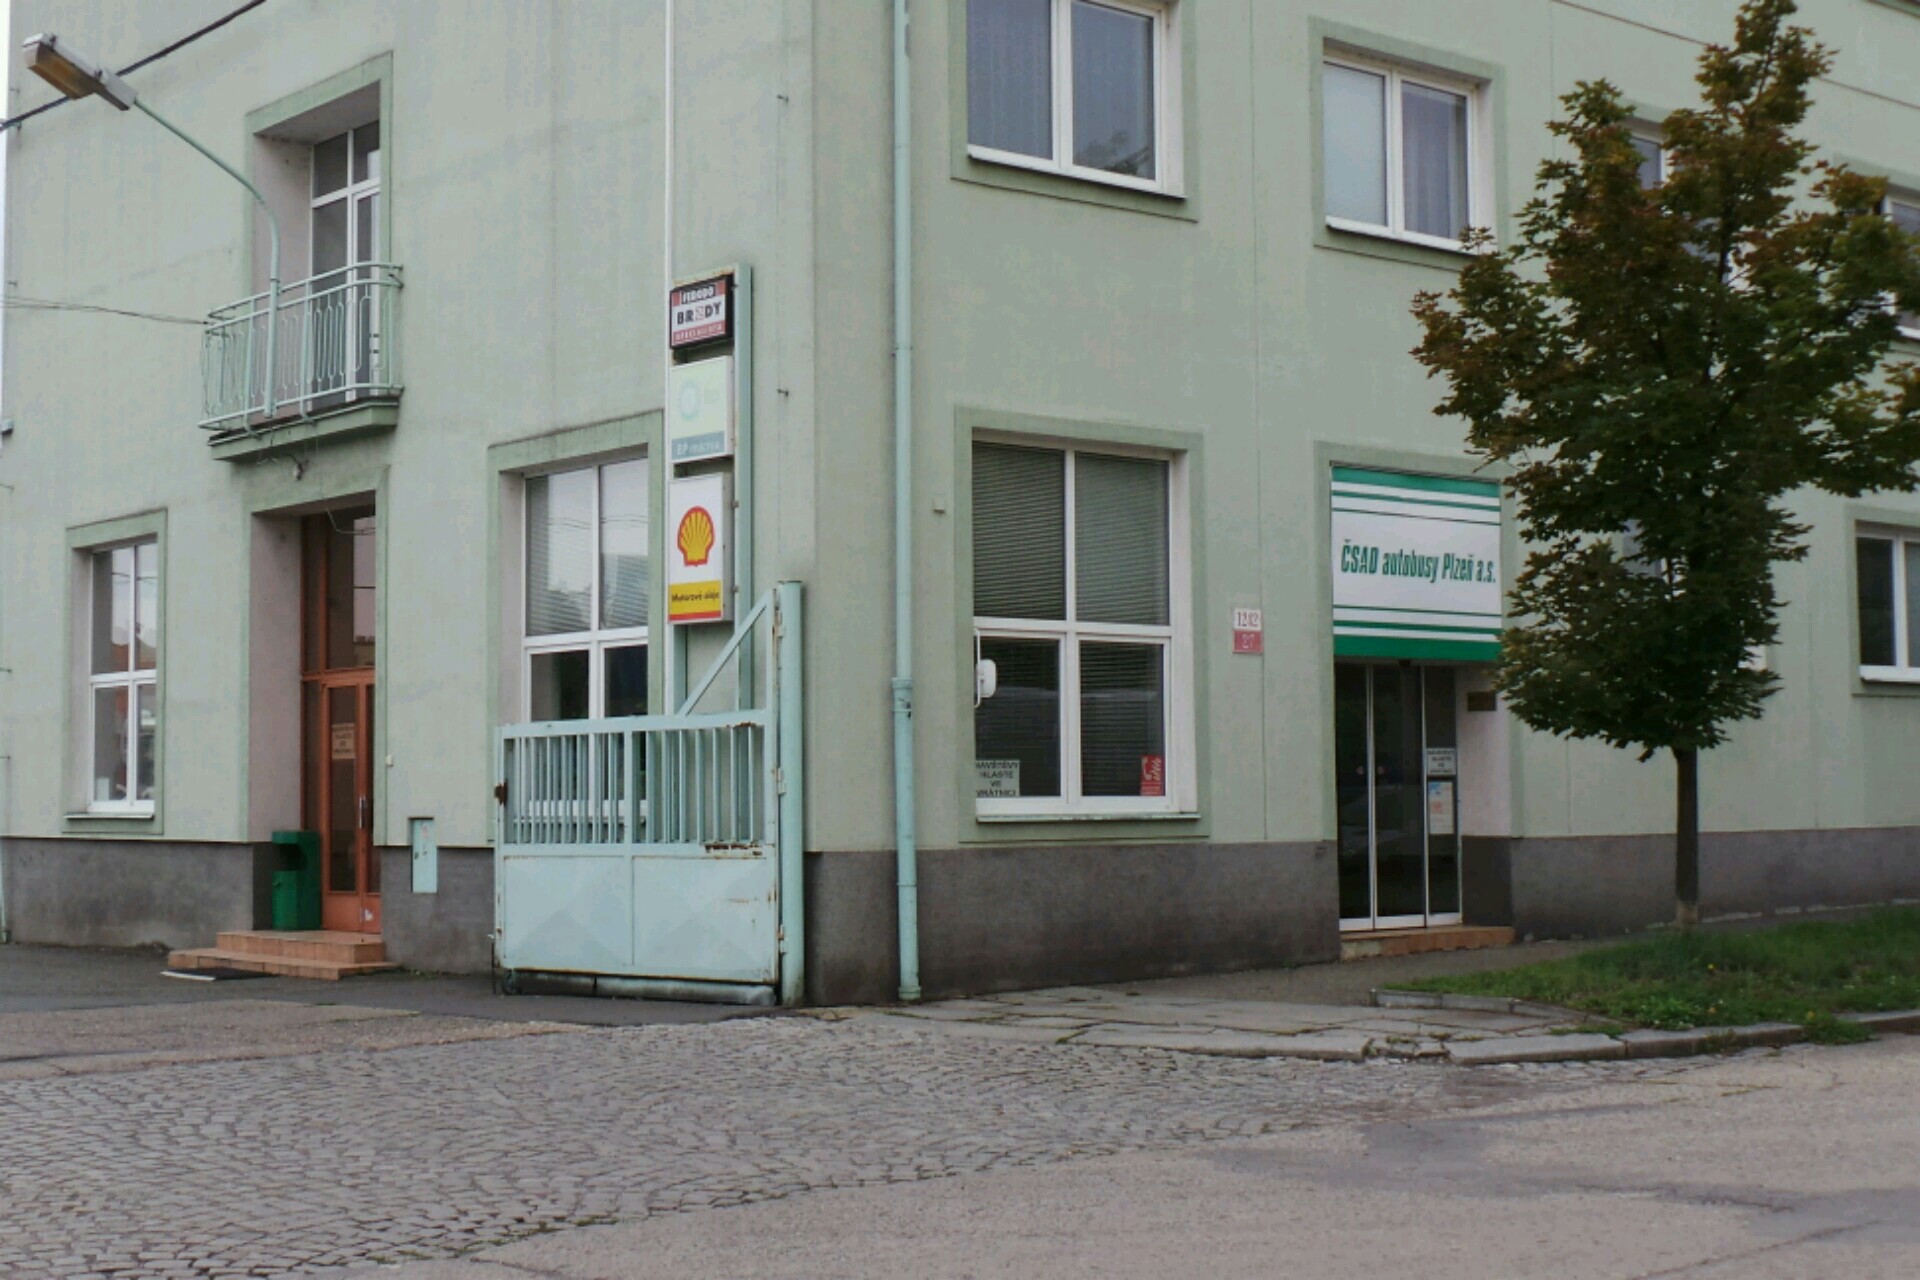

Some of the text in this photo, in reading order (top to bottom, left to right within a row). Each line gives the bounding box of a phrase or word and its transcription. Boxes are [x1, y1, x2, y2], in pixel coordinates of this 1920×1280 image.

[677, 301, 721, 325] BRZDY
[1341, 539, 1496, 584] ČSAD autobusy Plzeň a.s.
